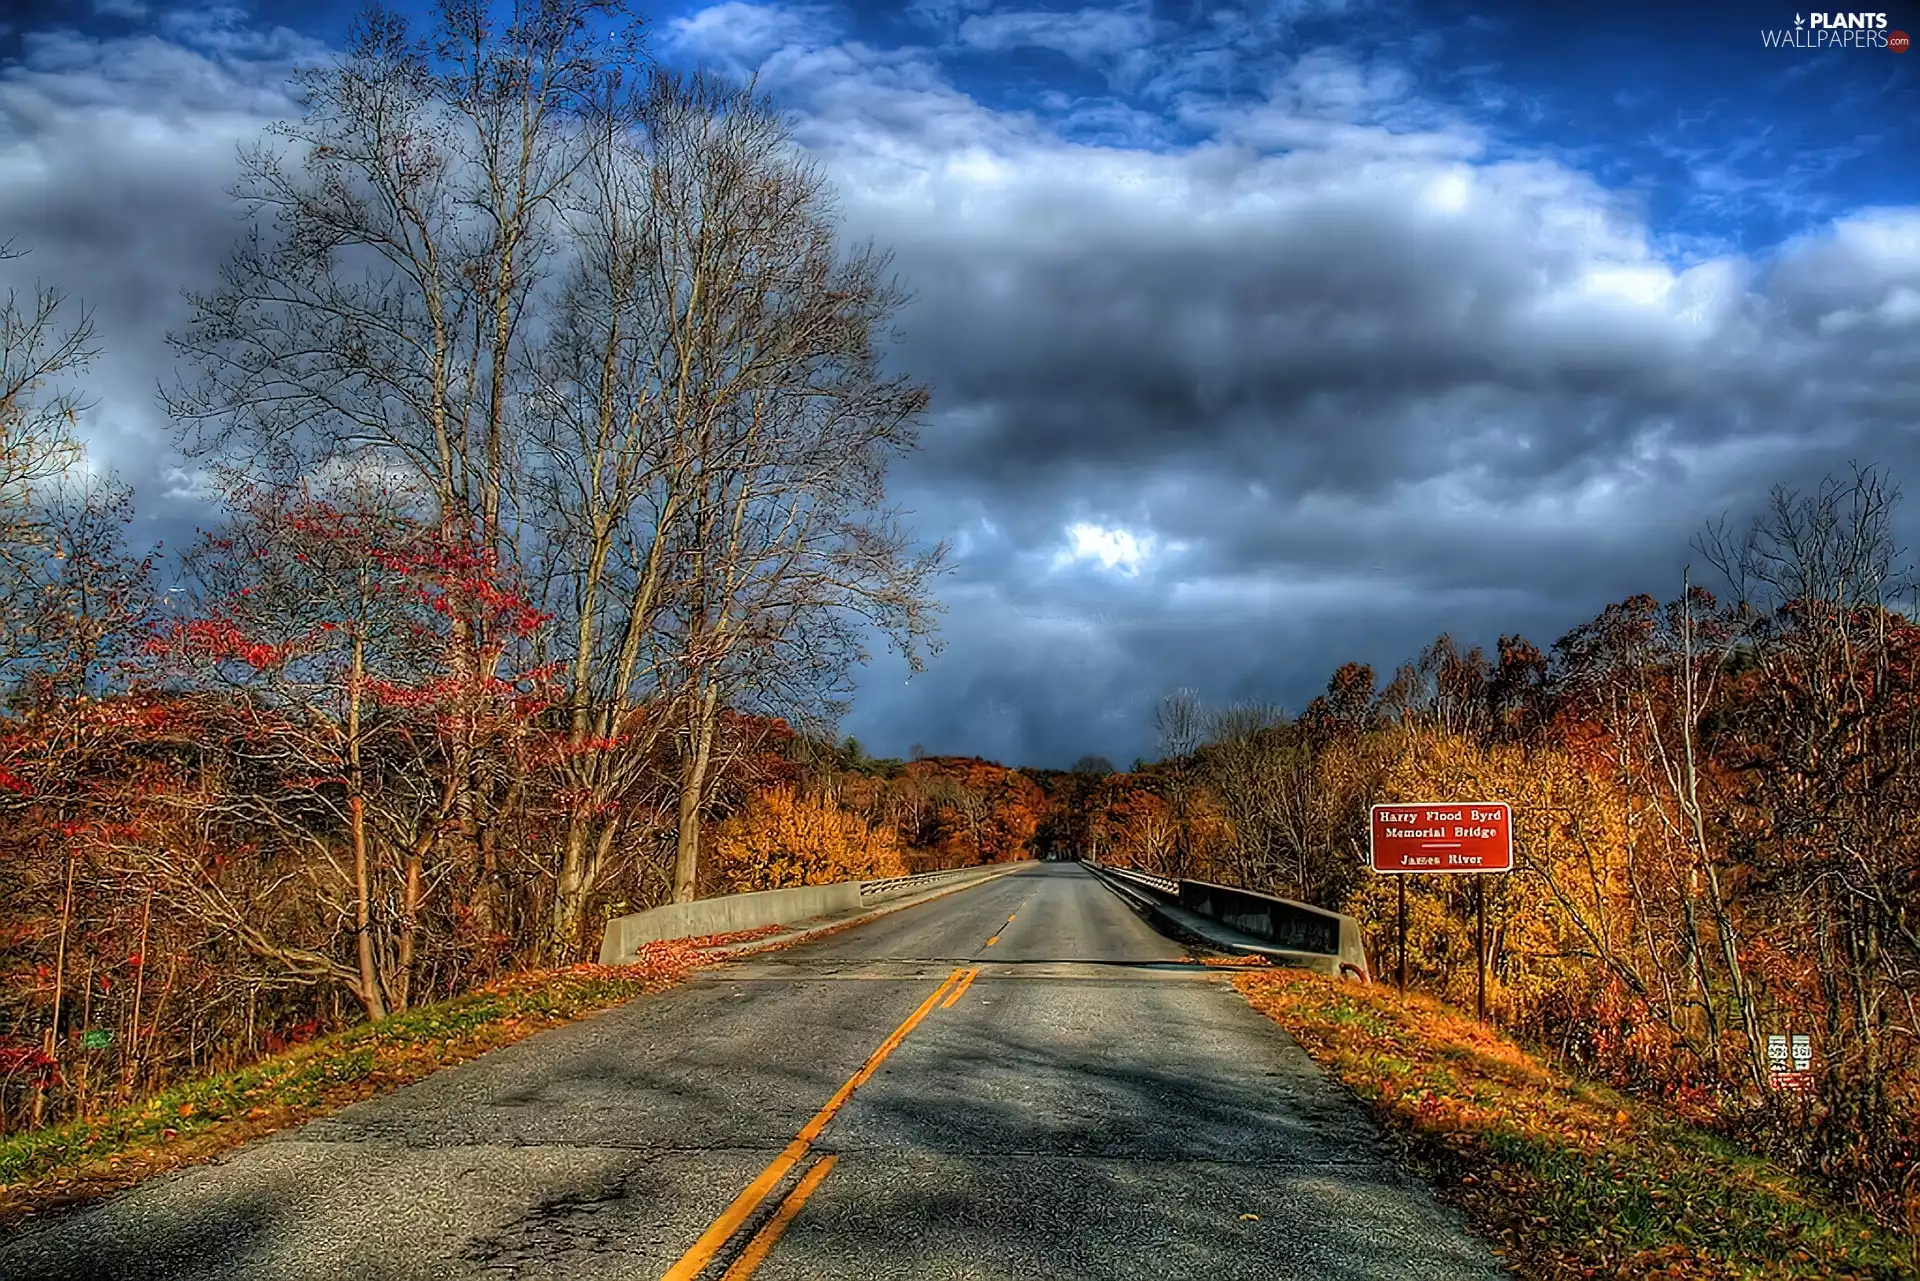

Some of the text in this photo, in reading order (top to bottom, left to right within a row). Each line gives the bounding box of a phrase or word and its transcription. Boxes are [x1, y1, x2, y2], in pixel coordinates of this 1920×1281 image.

[1379, 809, 1501, 824] Harry Flood Byrd
[1385, 826, 1497, 839] Memorial Bridge
[1400, 854, 1483, 866] James River
